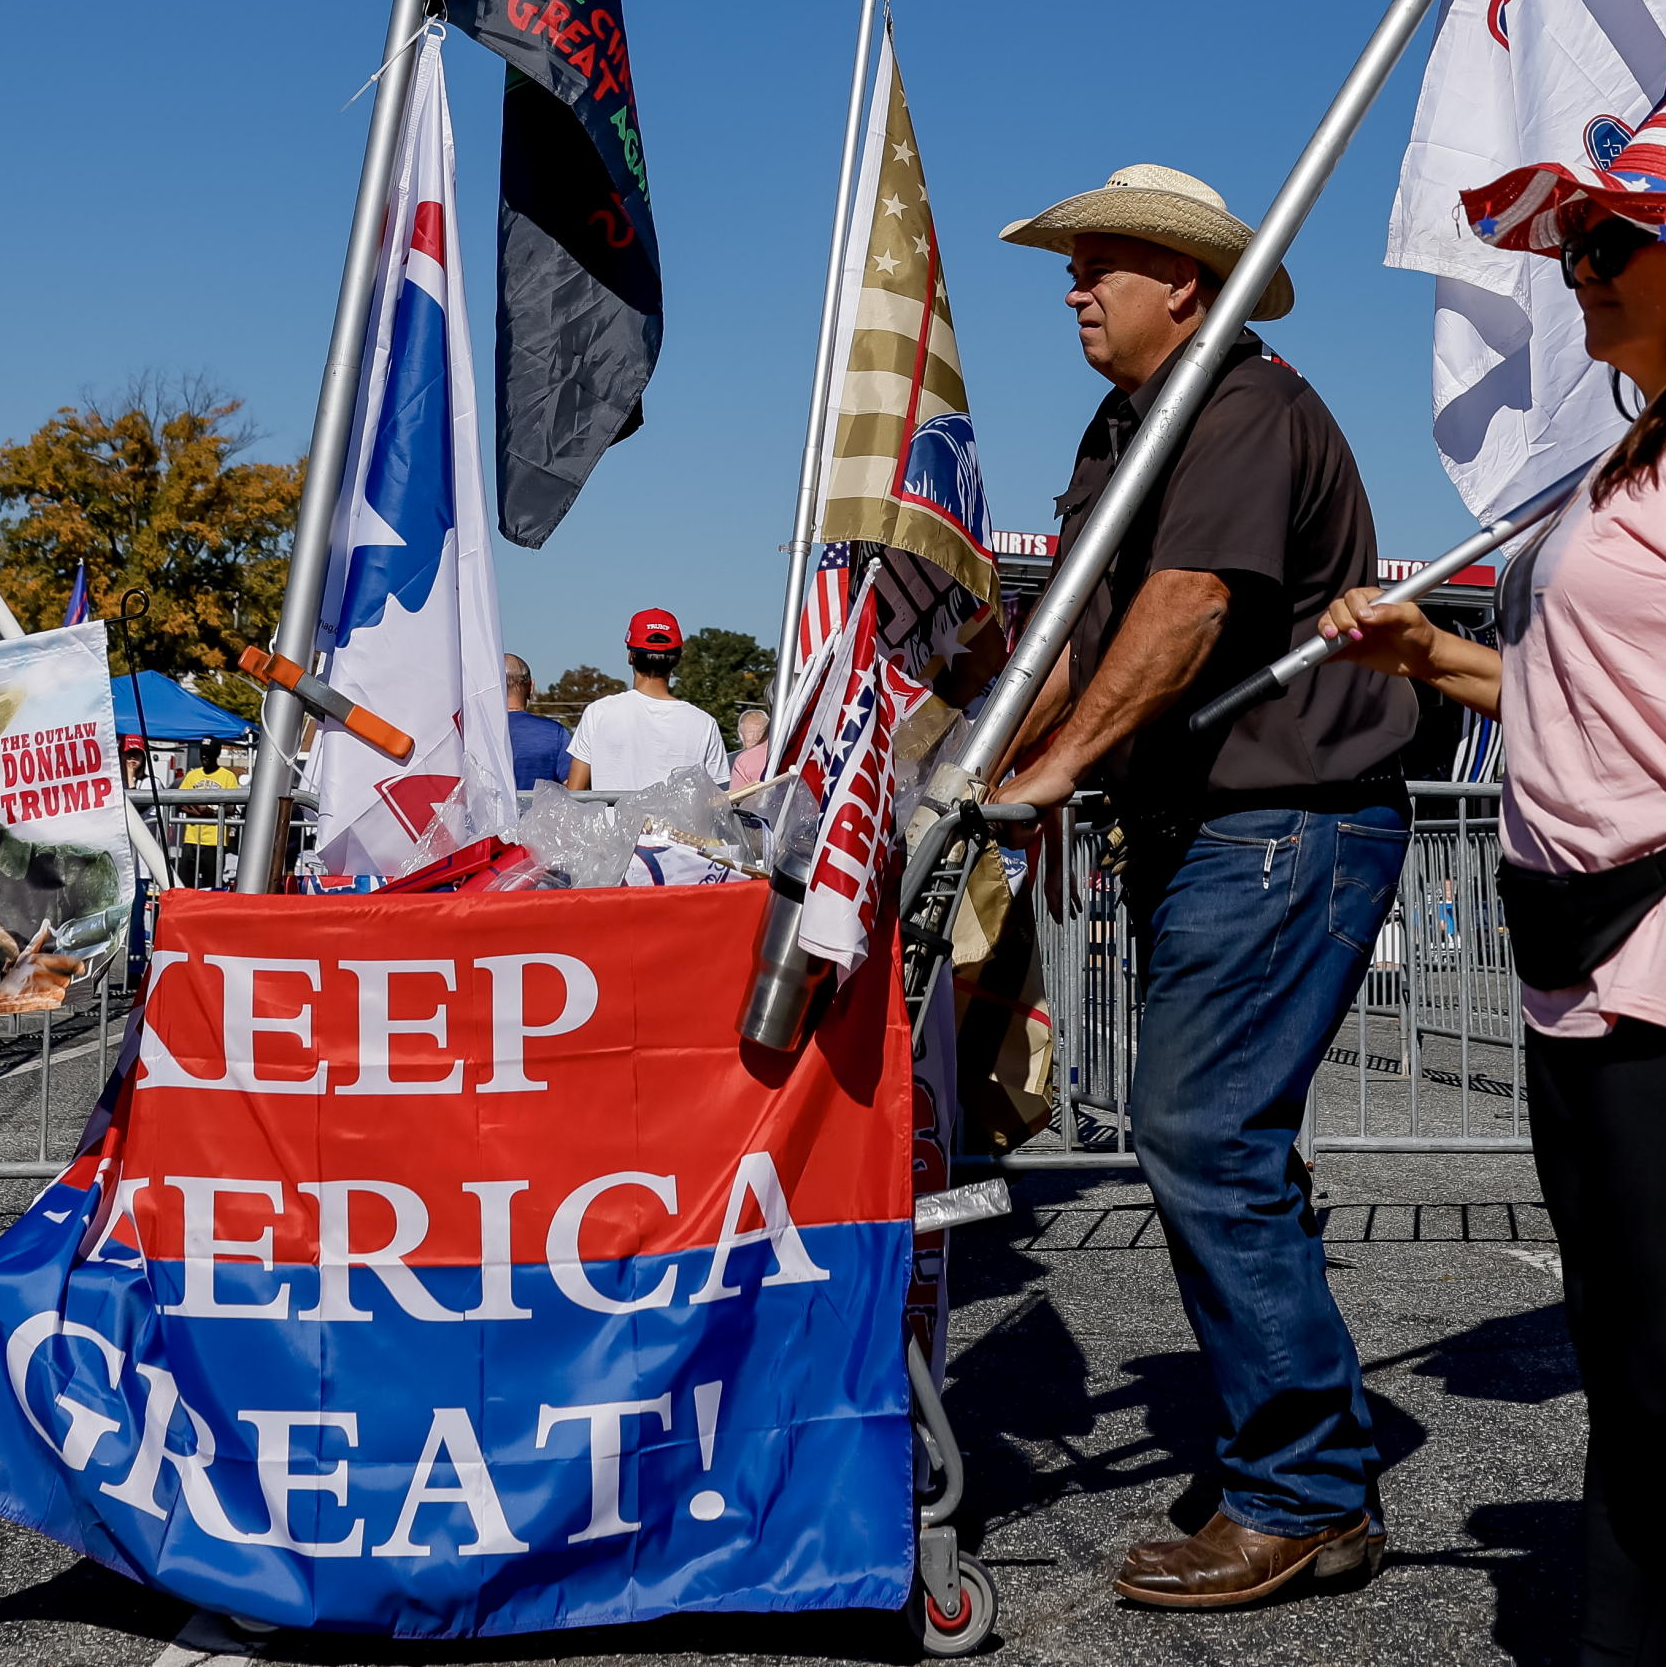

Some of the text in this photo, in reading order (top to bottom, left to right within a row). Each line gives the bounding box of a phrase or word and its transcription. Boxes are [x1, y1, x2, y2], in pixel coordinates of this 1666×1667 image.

[0, 734, 31, 753] THE
[34, 722, 98, 747] OUTLAW
[2, 738, 103, 789] DONALD
[0, 777, 112, 825] TRUMP
[5, 1309, 726, 1561] GREAT!
